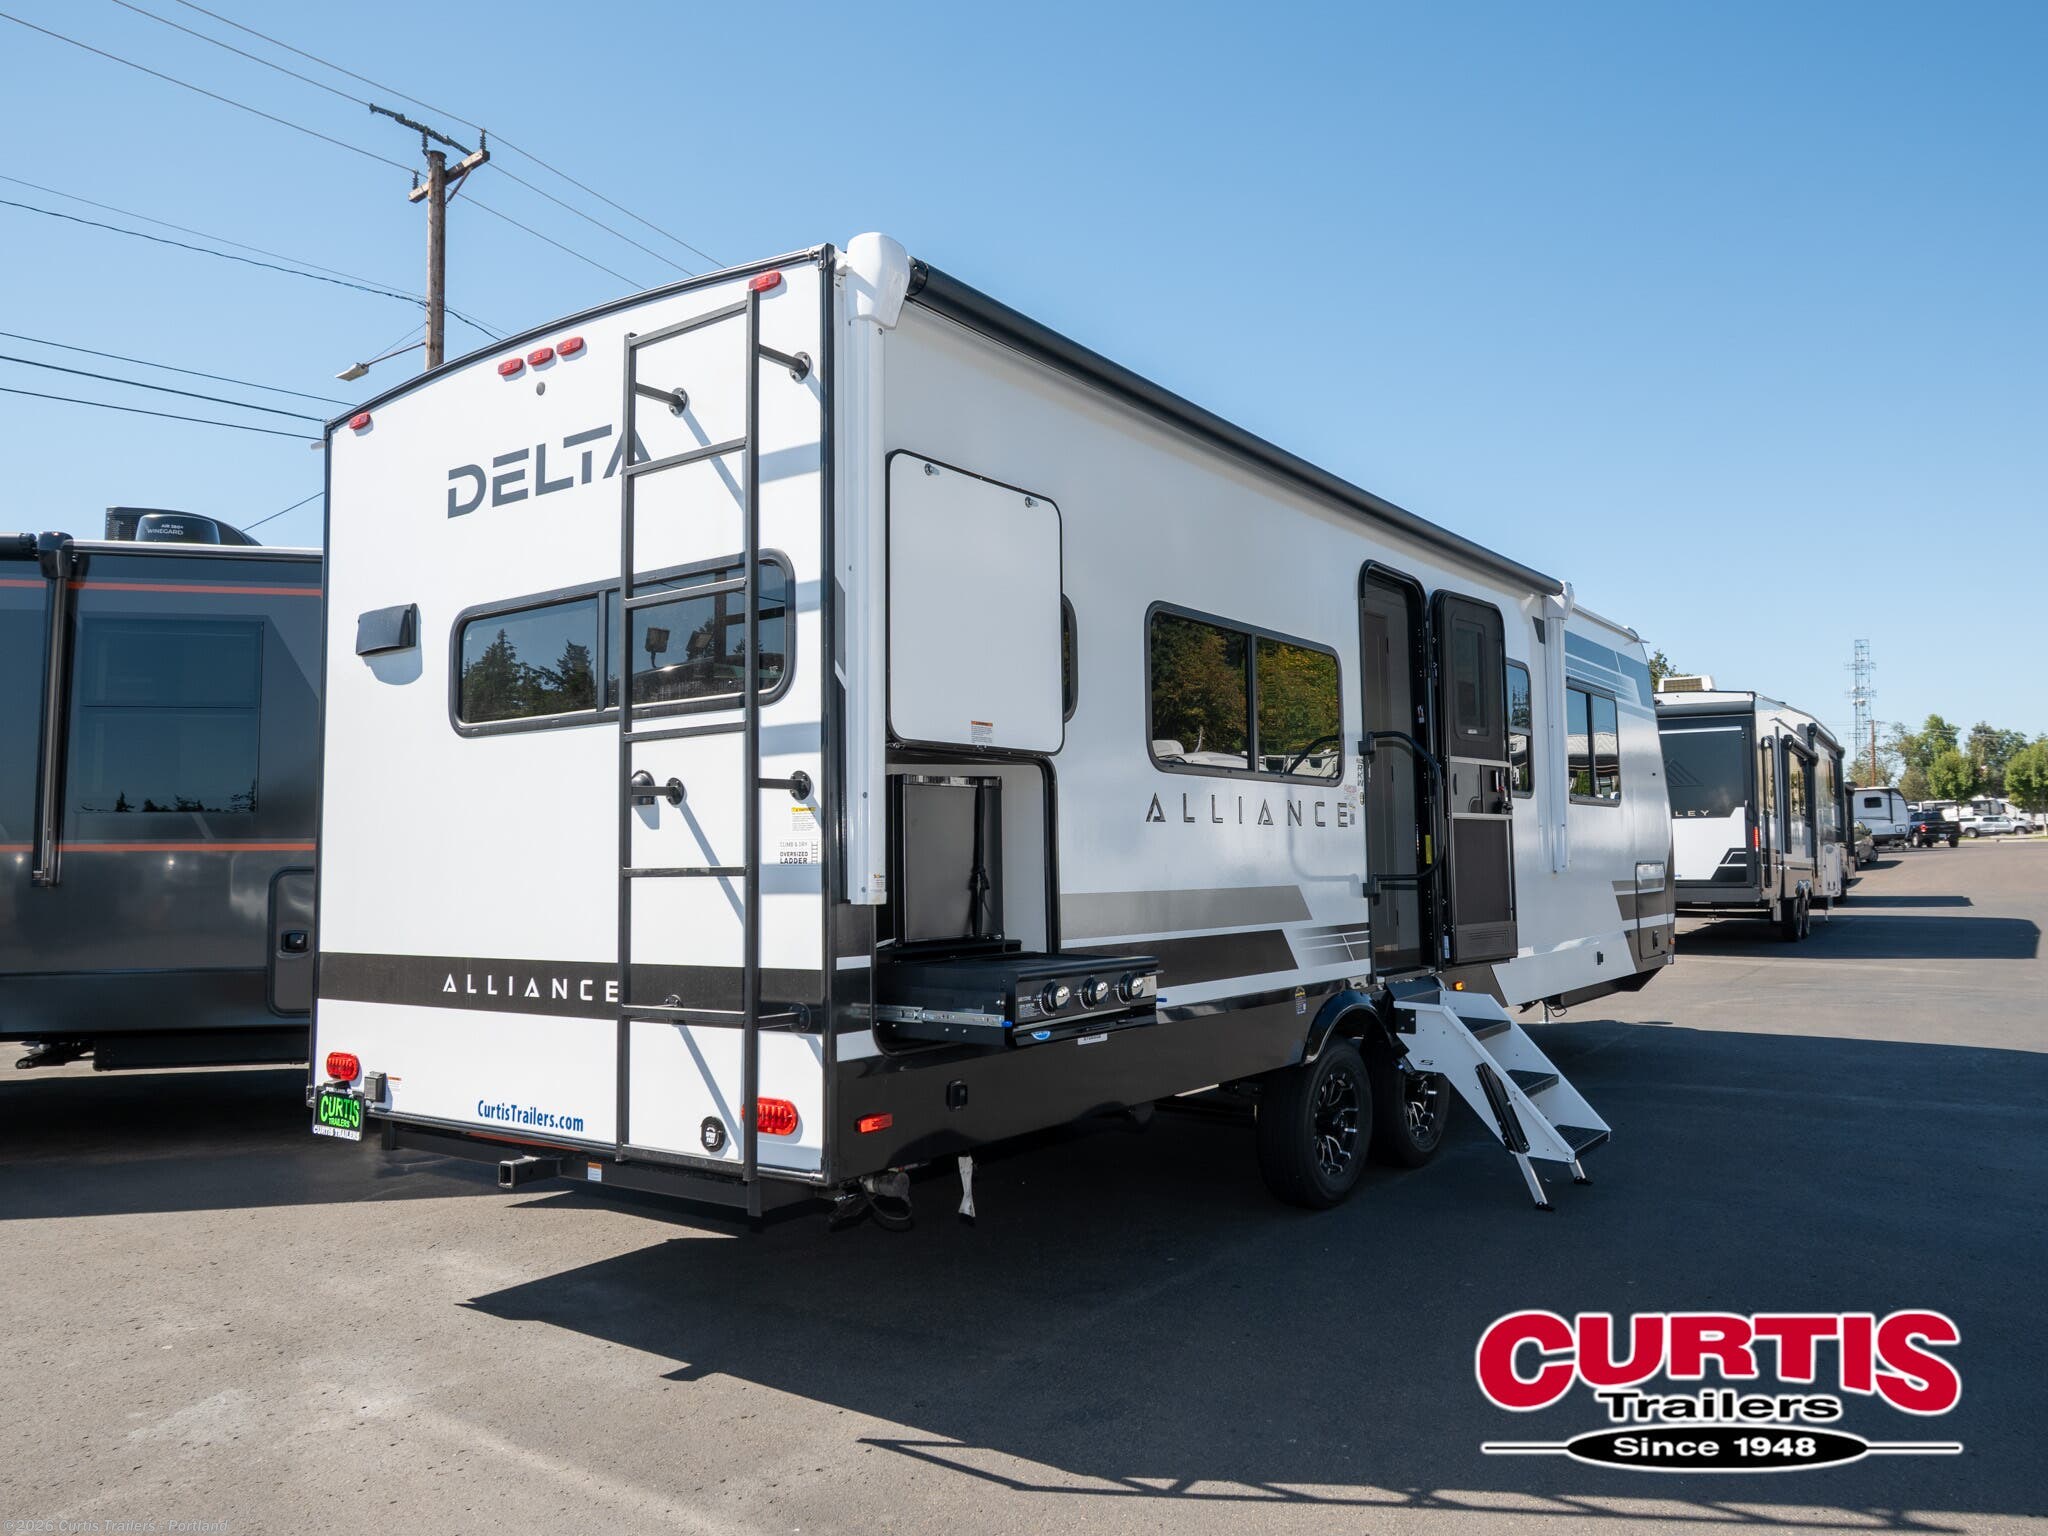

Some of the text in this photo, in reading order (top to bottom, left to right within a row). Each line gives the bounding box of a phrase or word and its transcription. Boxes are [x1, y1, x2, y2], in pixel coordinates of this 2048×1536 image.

[447, 424, 652, 519] DELTA
[1145, 792, 1348, 828] ALLIANCE
[780, 857, 808, 865] LADDER
[442, 973, 618, 1002] ALLIANCE
[320, 1095, 360, 1127] CURTIS
[328, 1117, 351, 1128] TRAILERS
[477, 1099, 584, 1132] CurtisTrailers.com
